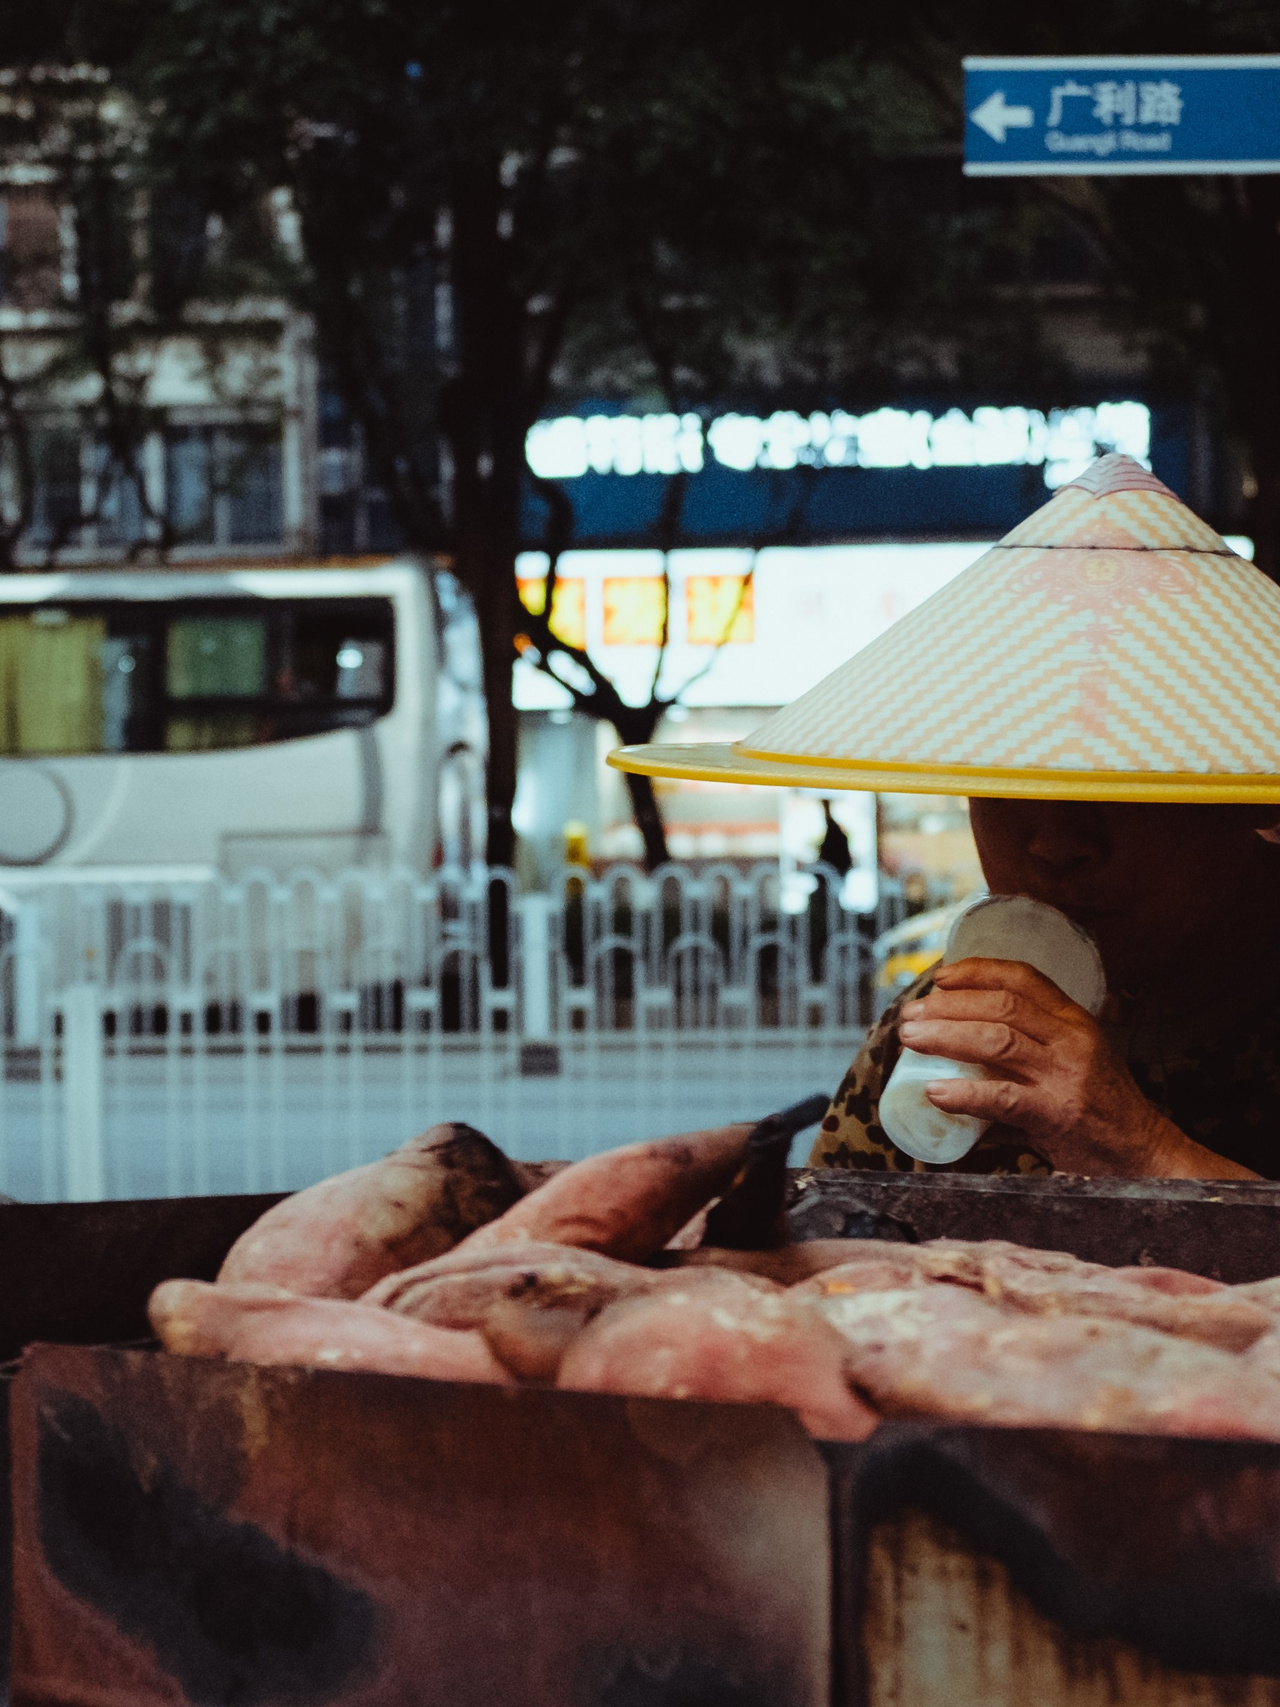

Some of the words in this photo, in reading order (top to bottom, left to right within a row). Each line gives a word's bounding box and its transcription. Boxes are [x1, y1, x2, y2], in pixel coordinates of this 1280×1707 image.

[1047, 80, 1184, 127] 广利路
[1120, 130, 1172, 151] Road
